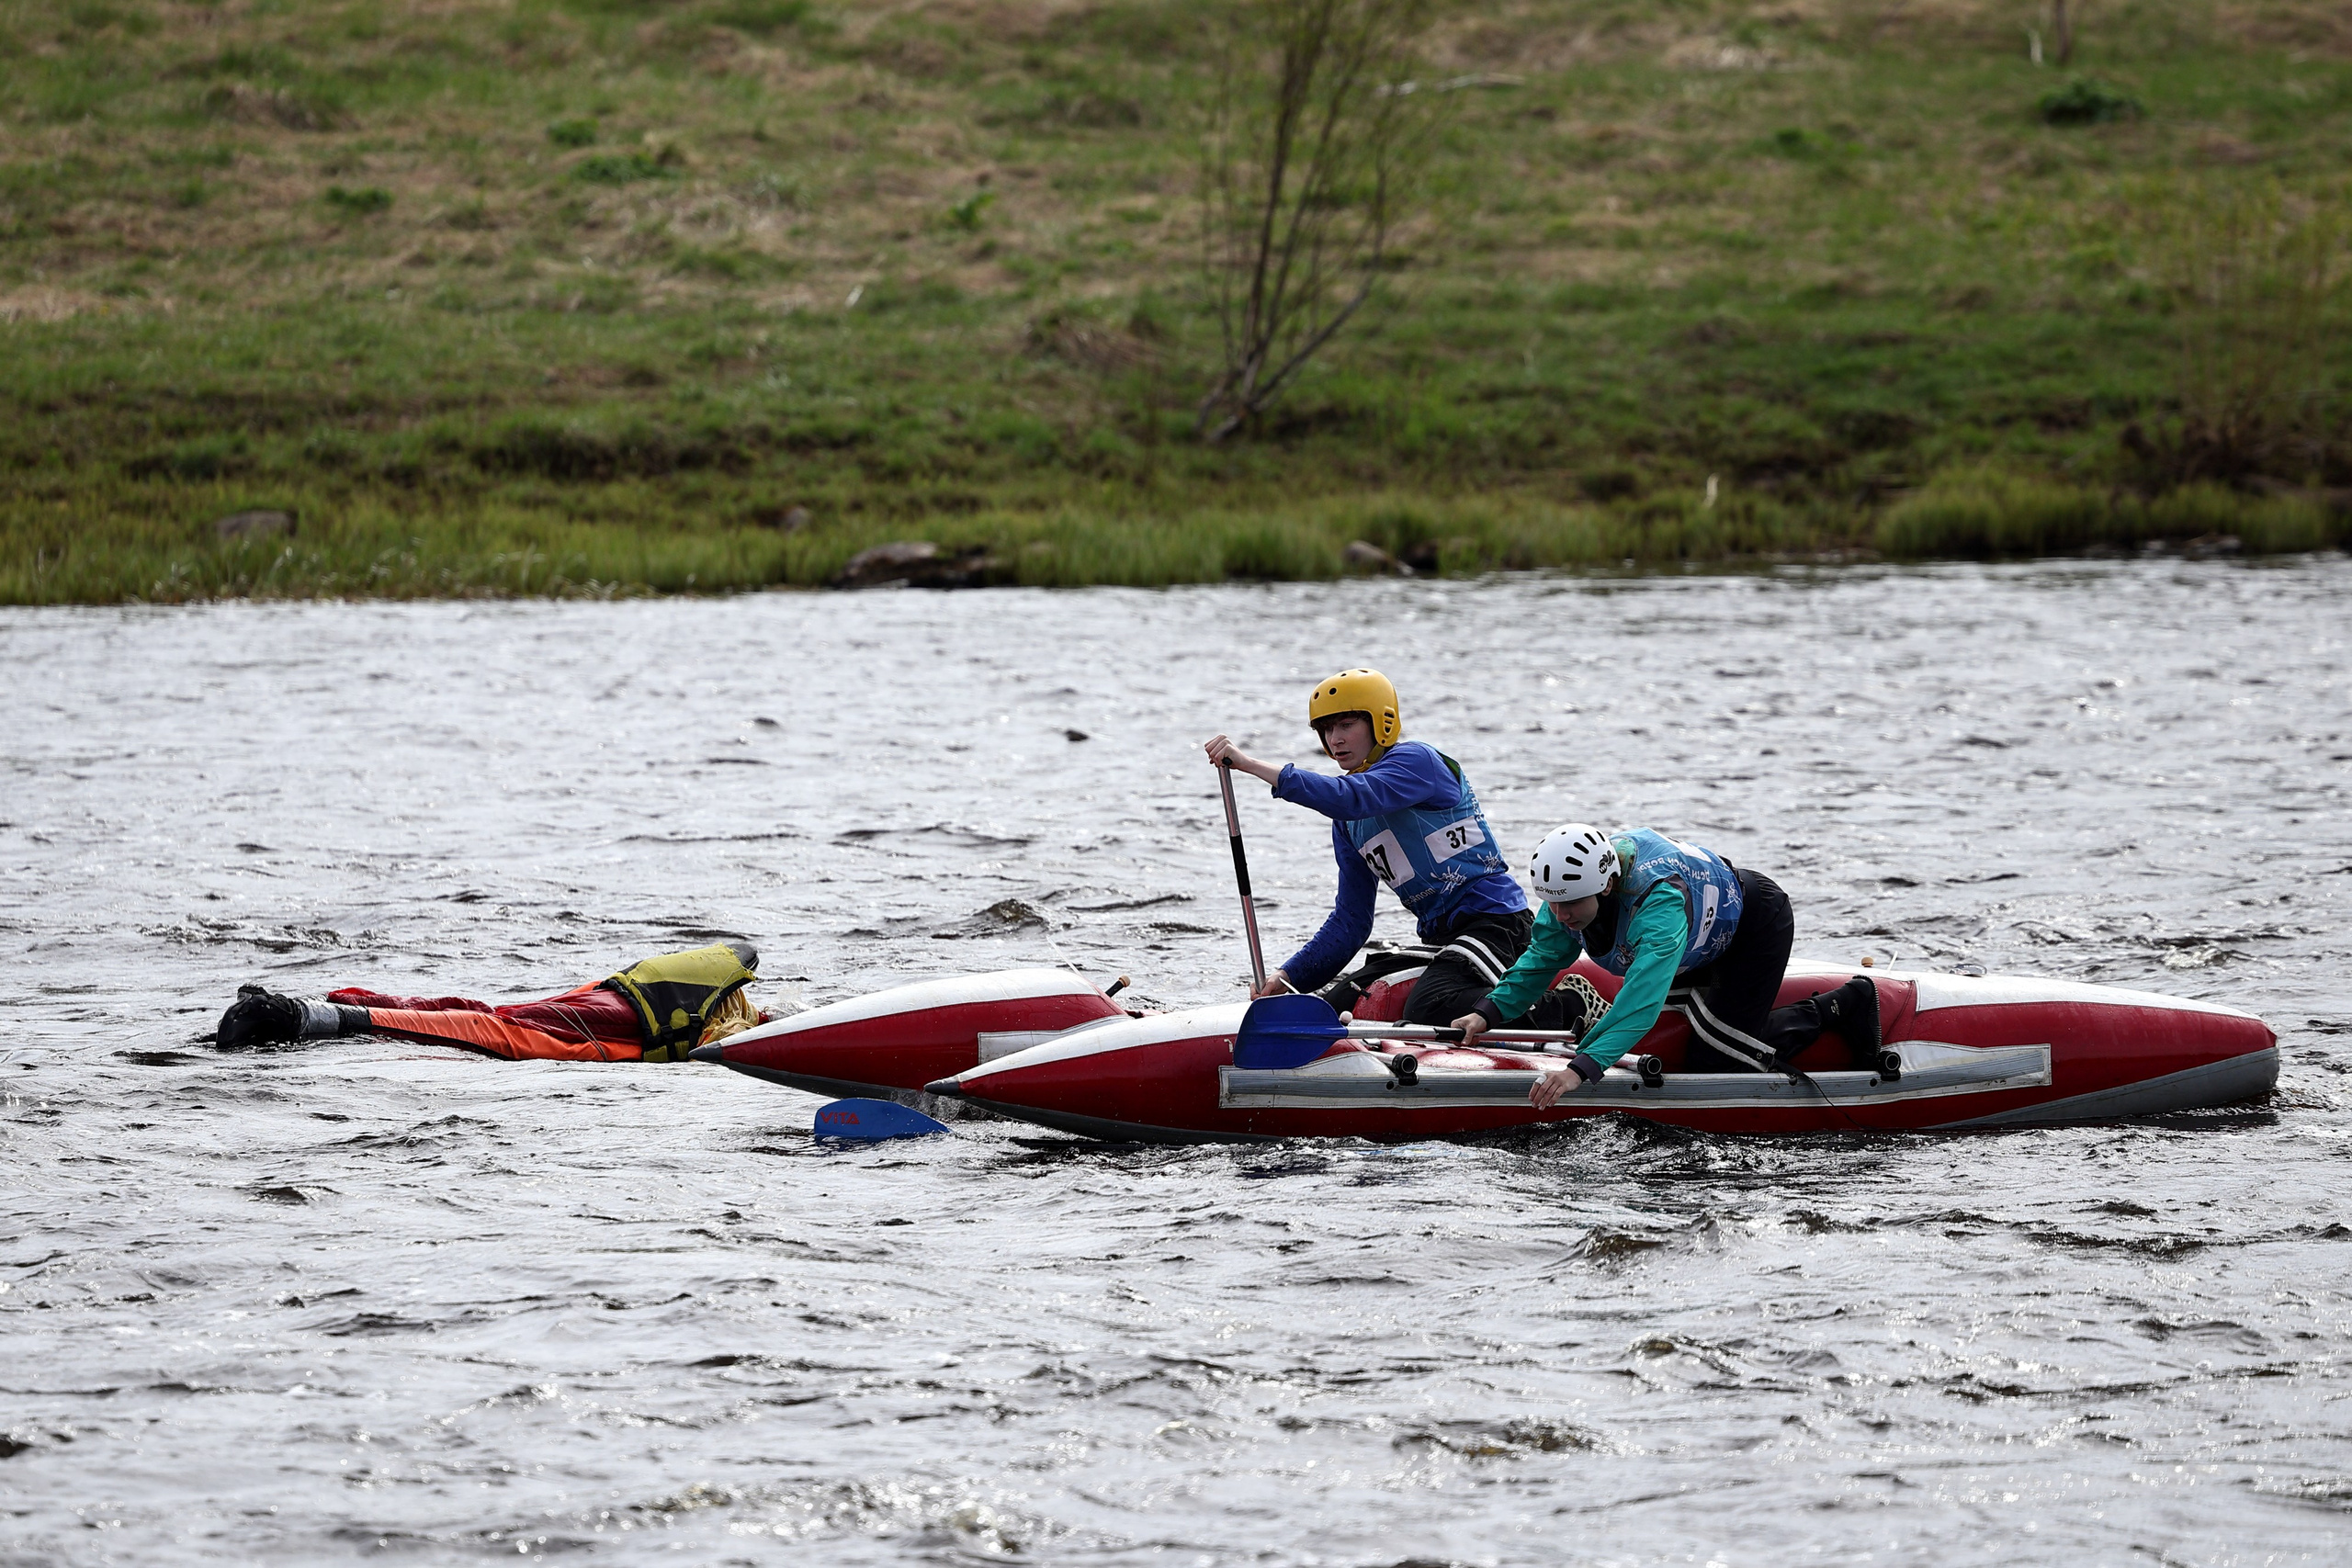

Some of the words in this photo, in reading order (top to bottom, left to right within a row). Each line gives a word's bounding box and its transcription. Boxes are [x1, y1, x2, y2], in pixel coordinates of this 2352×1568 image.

[1445, 826, 1467, 849] 37
[1365, 843, 1396, 883] 37
[820, 1111, 860, 1124] VITA
